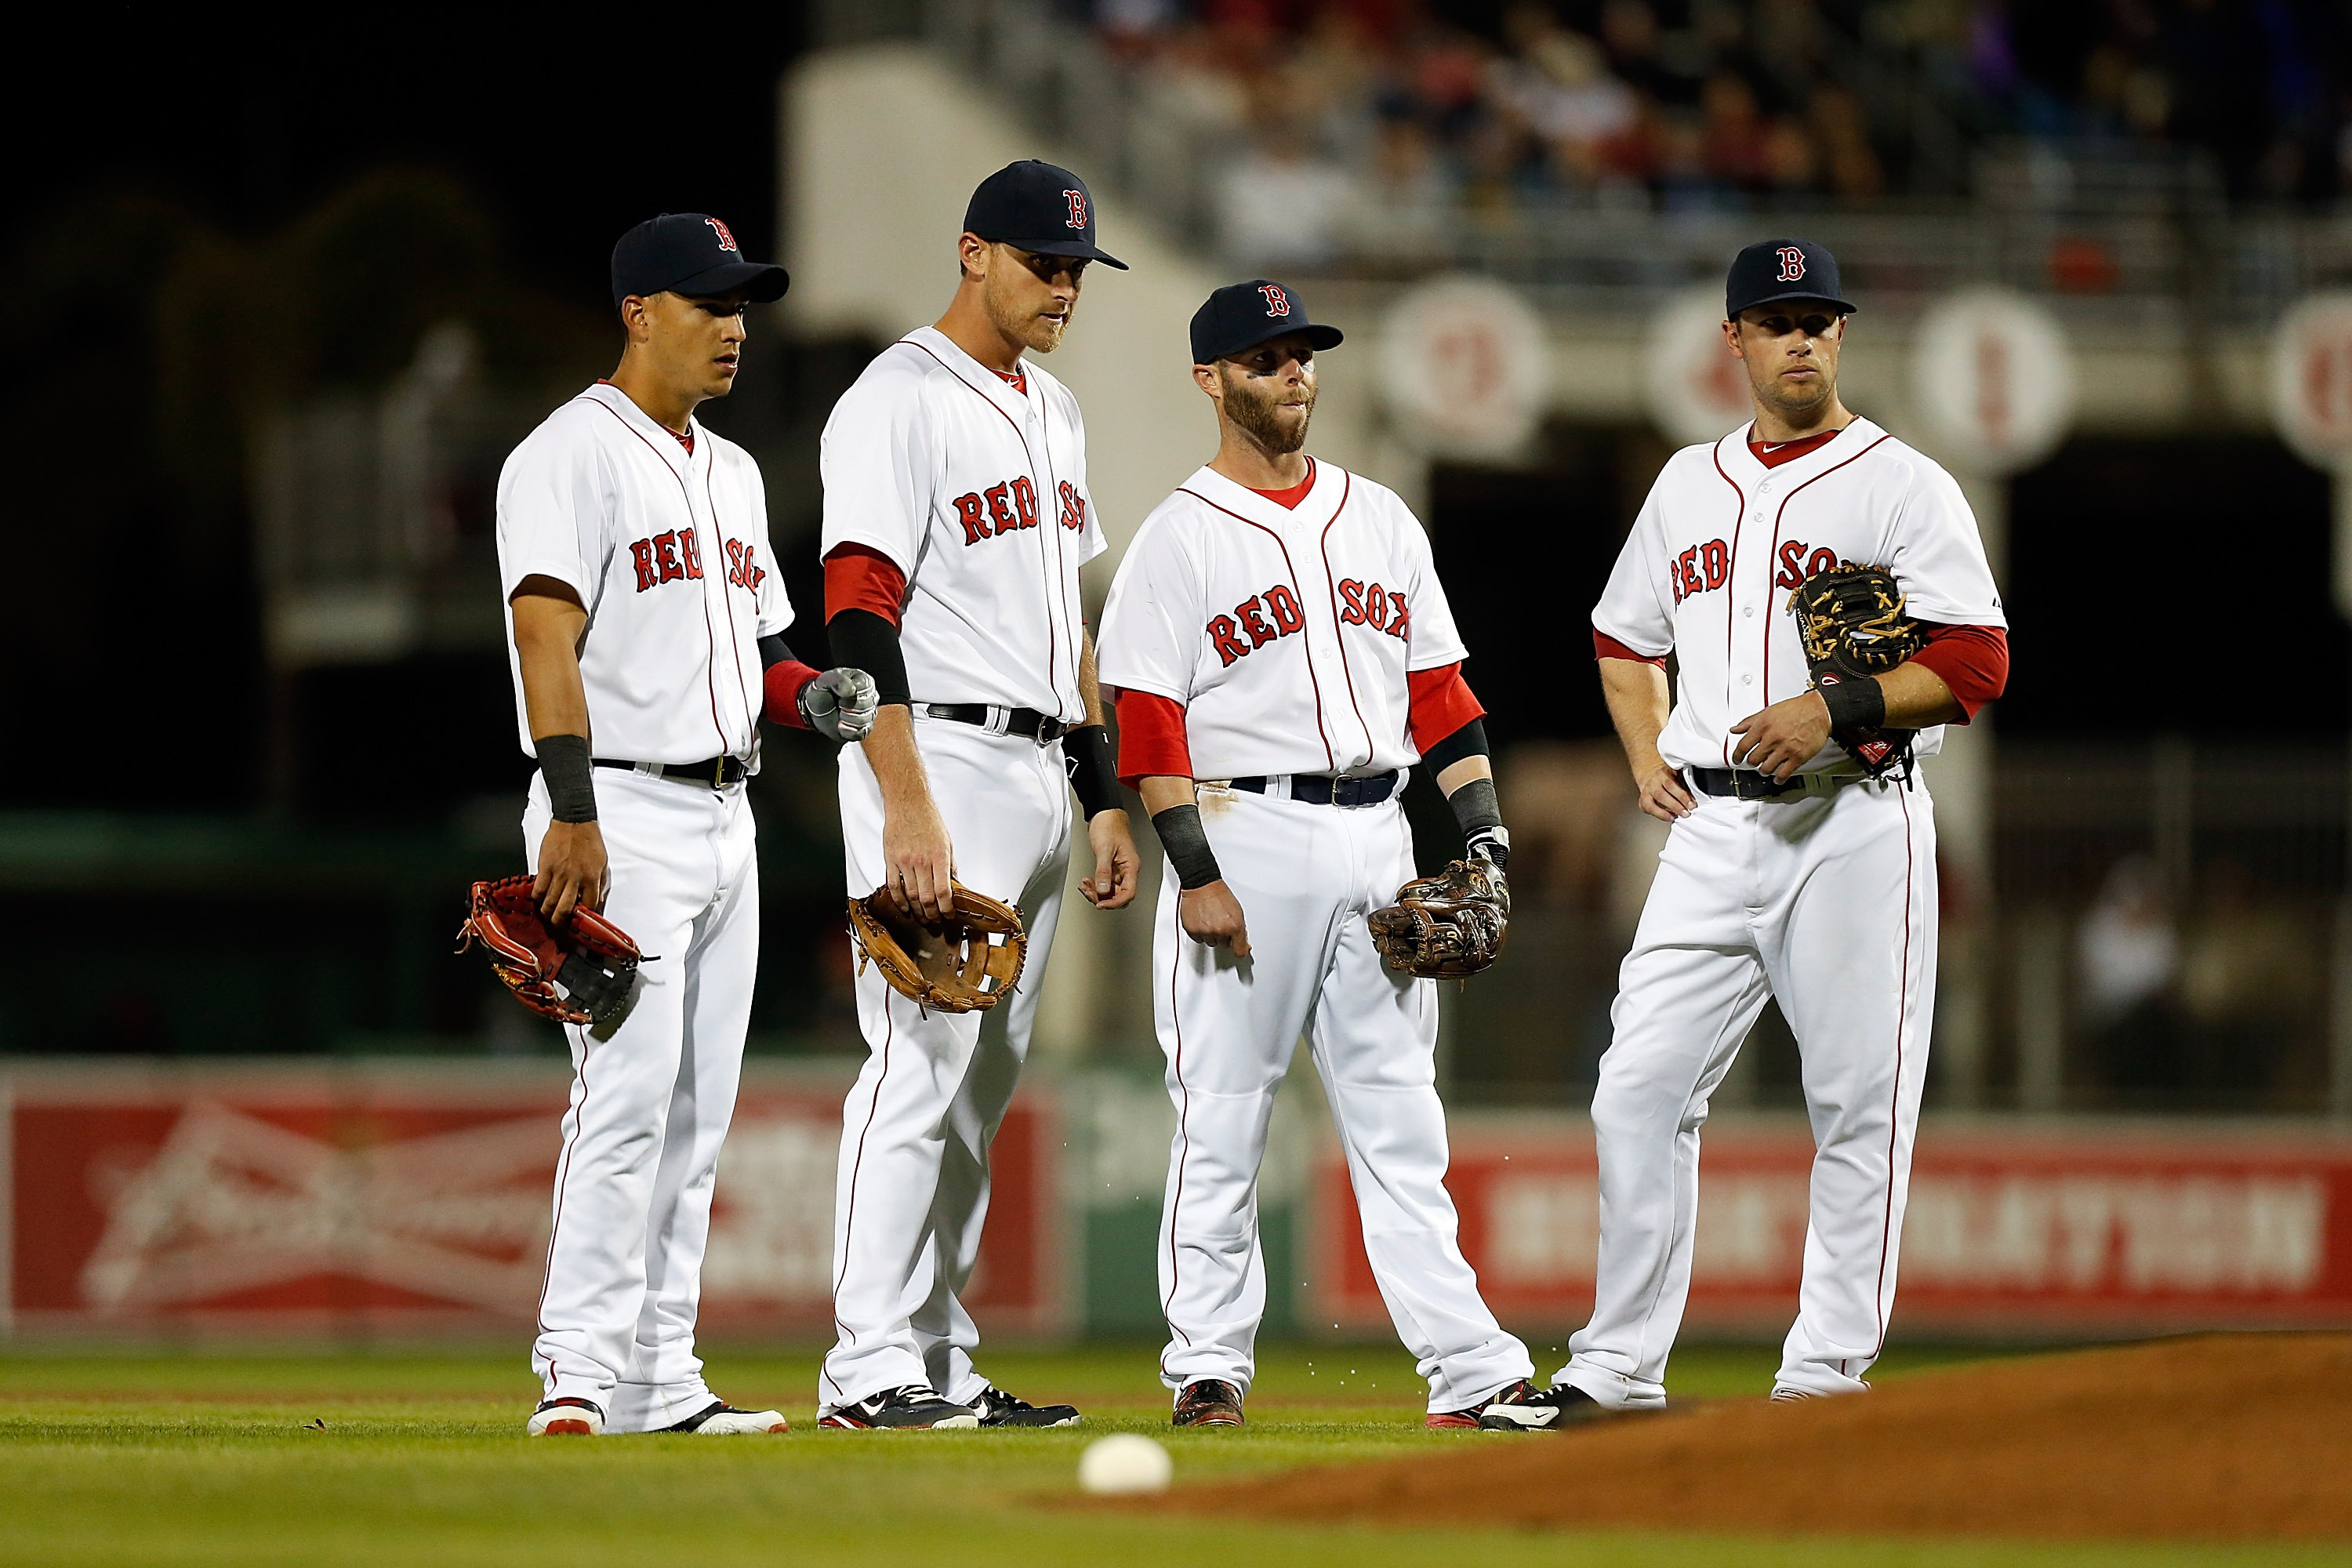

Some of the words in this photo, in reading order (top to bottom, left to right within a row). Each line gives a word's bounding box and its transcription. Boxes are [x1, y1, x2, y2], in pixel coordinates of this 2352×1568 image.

[1062, 188, 1087, 230] B
[705, 218, 737, 252] B
[1777, 247, 1806, 281] B
[1258, 285, 1290, 317] B
[952, 475, 1038, 546] RED
[629, 528, 703, 593] RED
[1777, 540, 1853, 591] SO
[1207, 585, 1305, 668] RED
[1338, 579, 1409, 644] SOX
